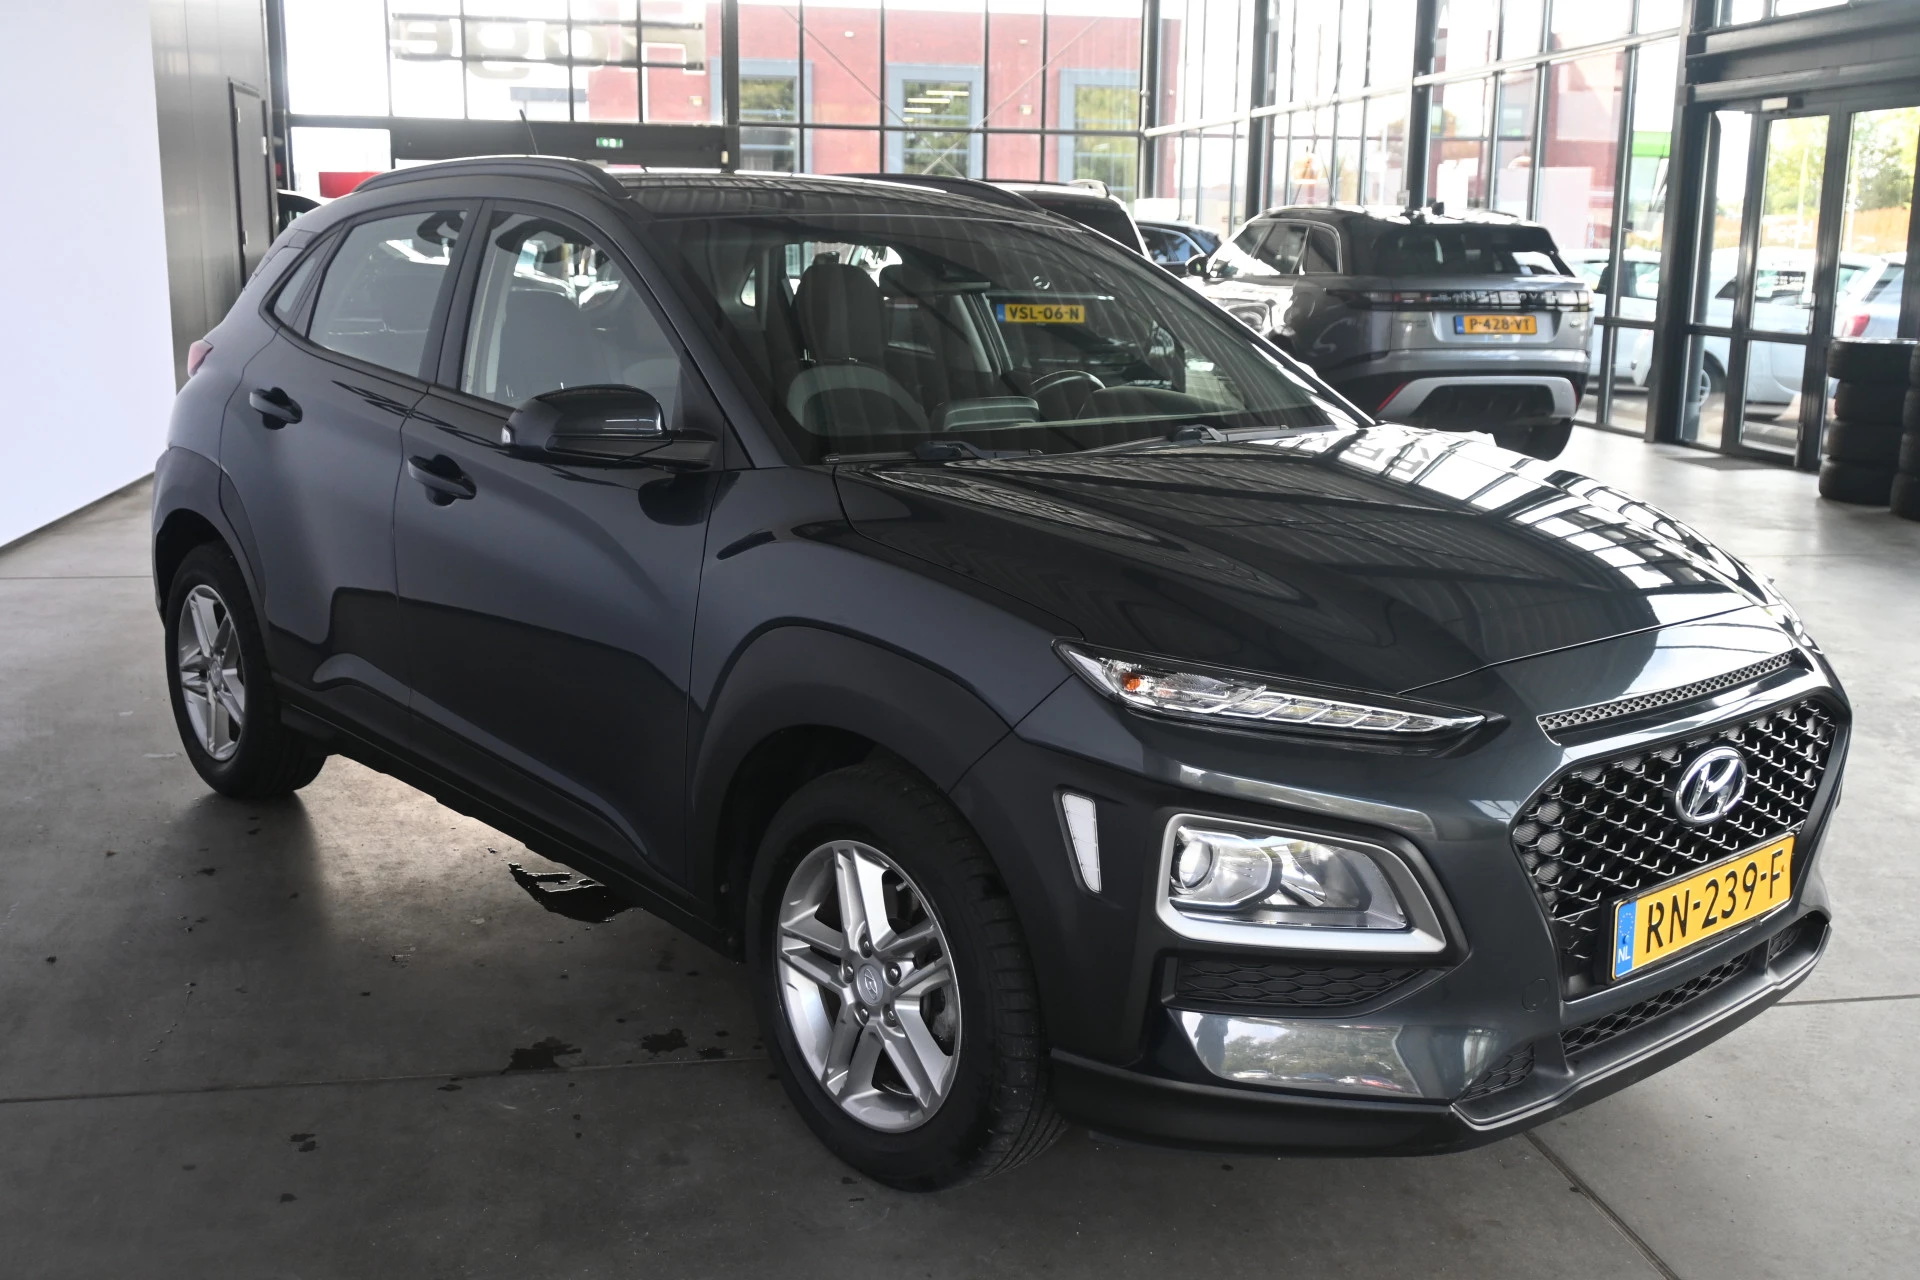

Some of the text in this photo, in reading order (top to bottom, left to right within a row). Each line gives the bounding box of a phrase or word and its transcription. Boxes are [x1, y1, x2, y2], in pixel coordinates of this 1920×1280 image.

[1009, 306, 1079, 320] VSL-06-N
[1469, 317, 1531, 331] P-428-VT
[1645, 848, 1784, 954] RN-239-F
[1617, 945, 1631, 963] NL
